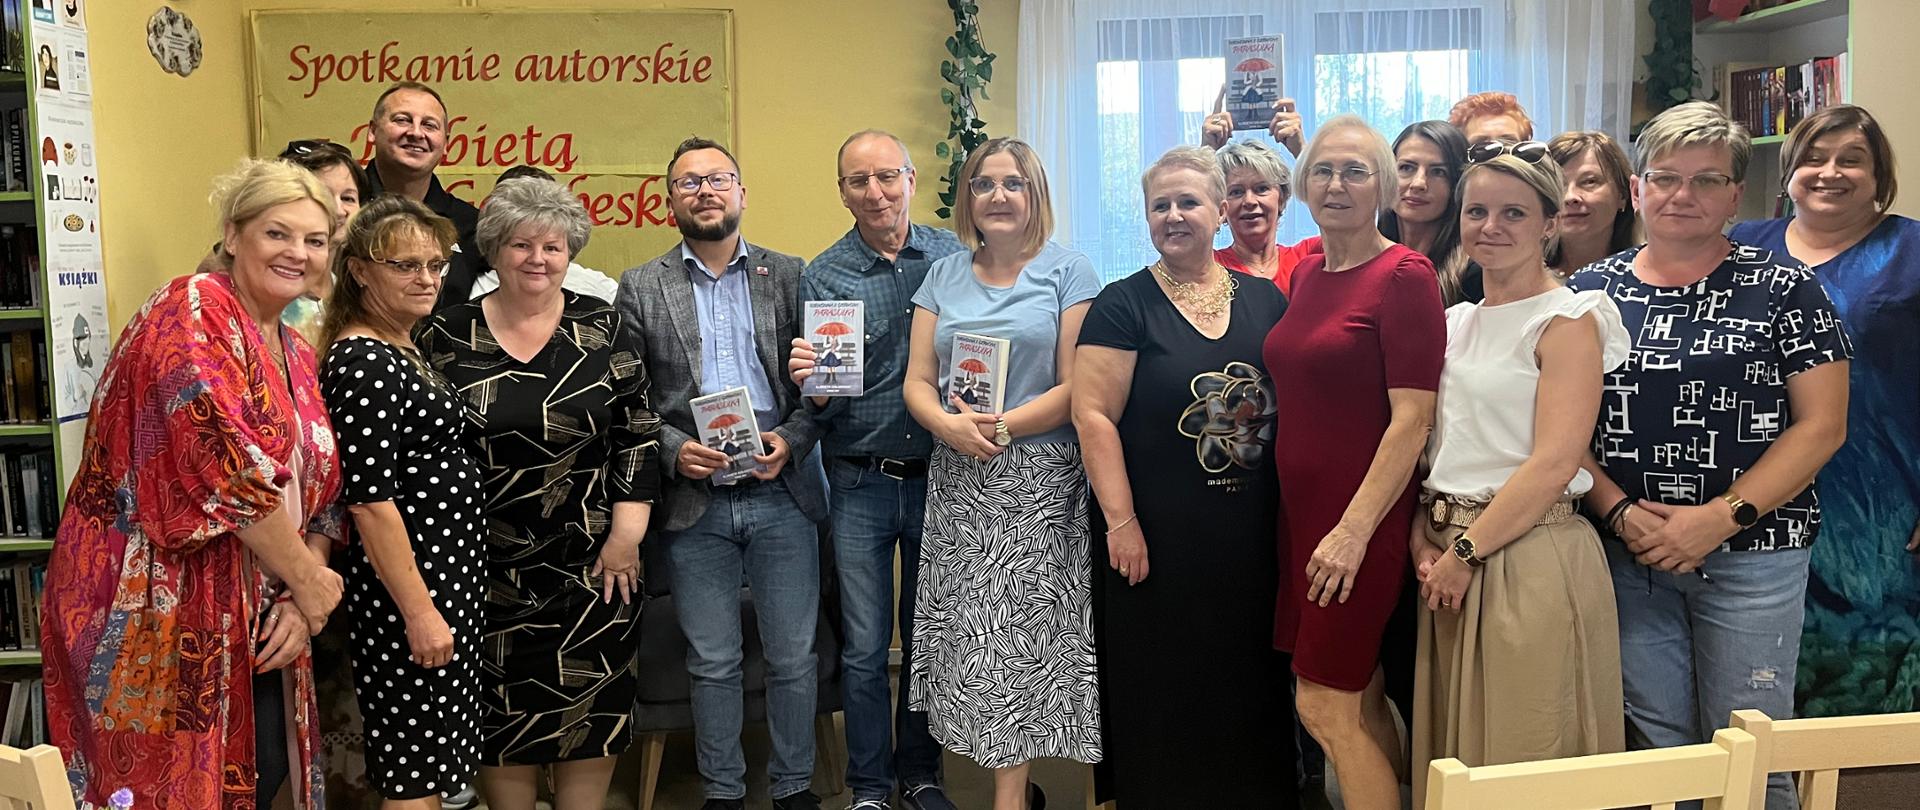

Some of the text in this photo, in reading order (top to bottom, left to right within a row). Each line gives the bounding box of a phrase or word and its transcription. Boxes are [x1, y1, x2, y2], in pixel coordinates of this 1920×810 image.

[288, 41, 713, 98] Spotkanie autorskie
[350, 116, 579, 172] bietą
[58, 268, 98, 289] KSIĄŻKI
